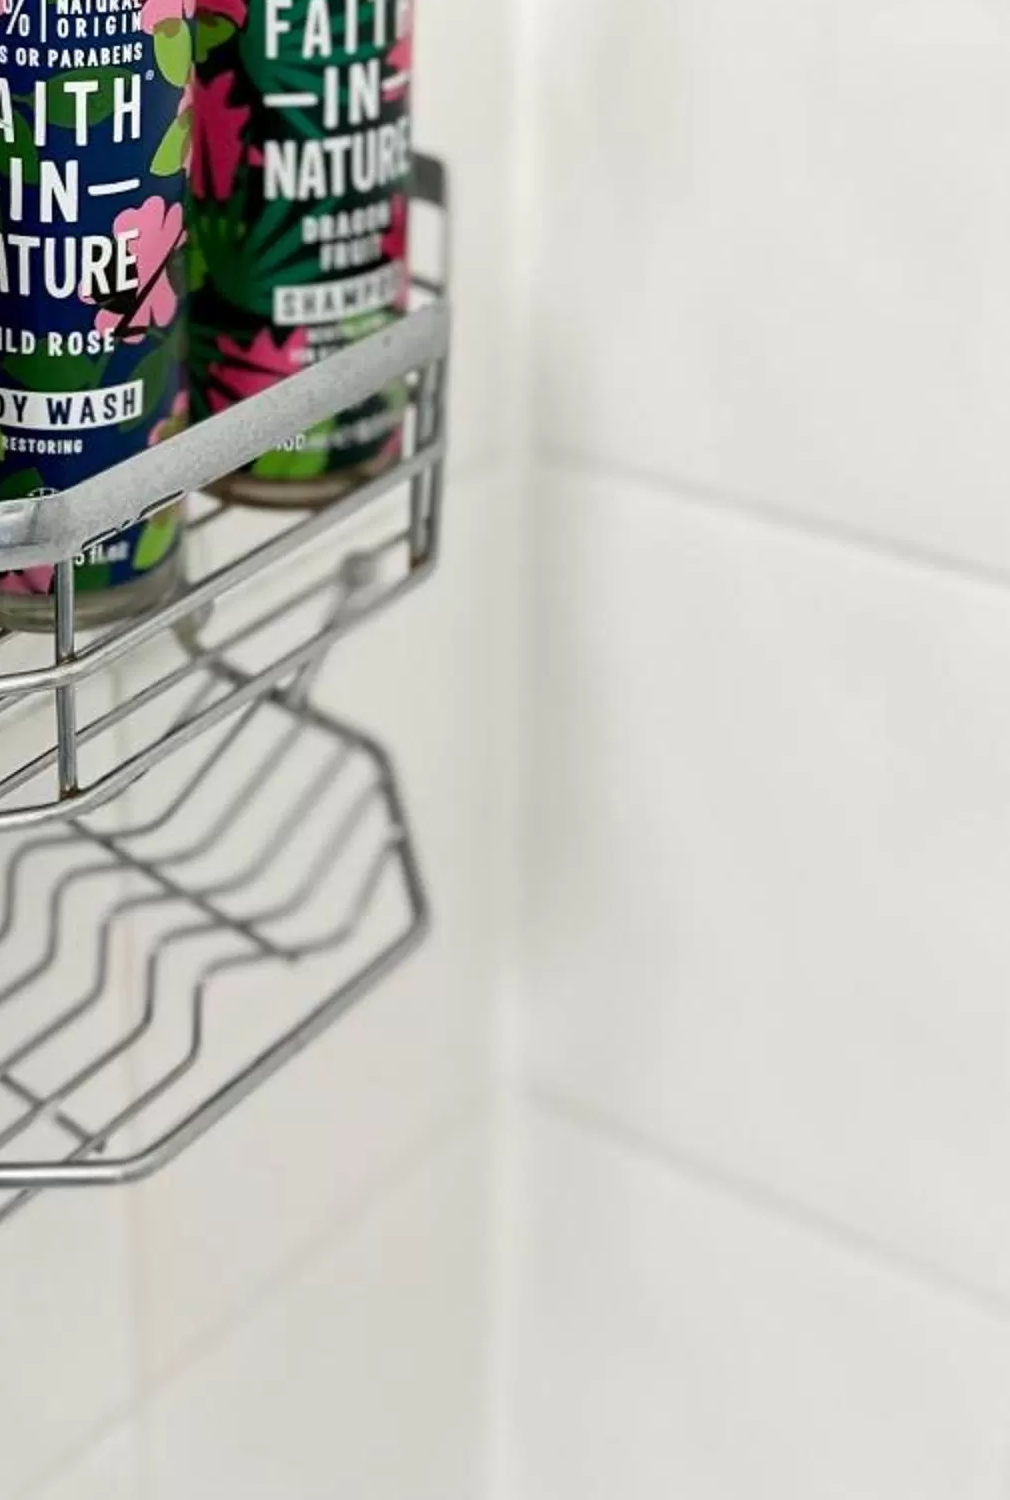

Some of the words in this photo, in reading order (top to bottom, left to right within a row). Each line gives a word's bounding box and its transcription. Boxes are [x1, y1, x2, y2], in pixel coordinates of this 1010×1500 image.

[56, 11, 142, 39] ORIGIN
[15, 48, 40, 67] OR
[47, 42, 143, 69] PARABENS
[323, 58, 381, 130] IN
[263, 115, 412, 201] NATURE
[9, 157, 79, 223] IN
[47, 328, 116, 357] ROSE
[46, 387, 137, 426] WASH
[1, 435, 84, 454] RESTORING
